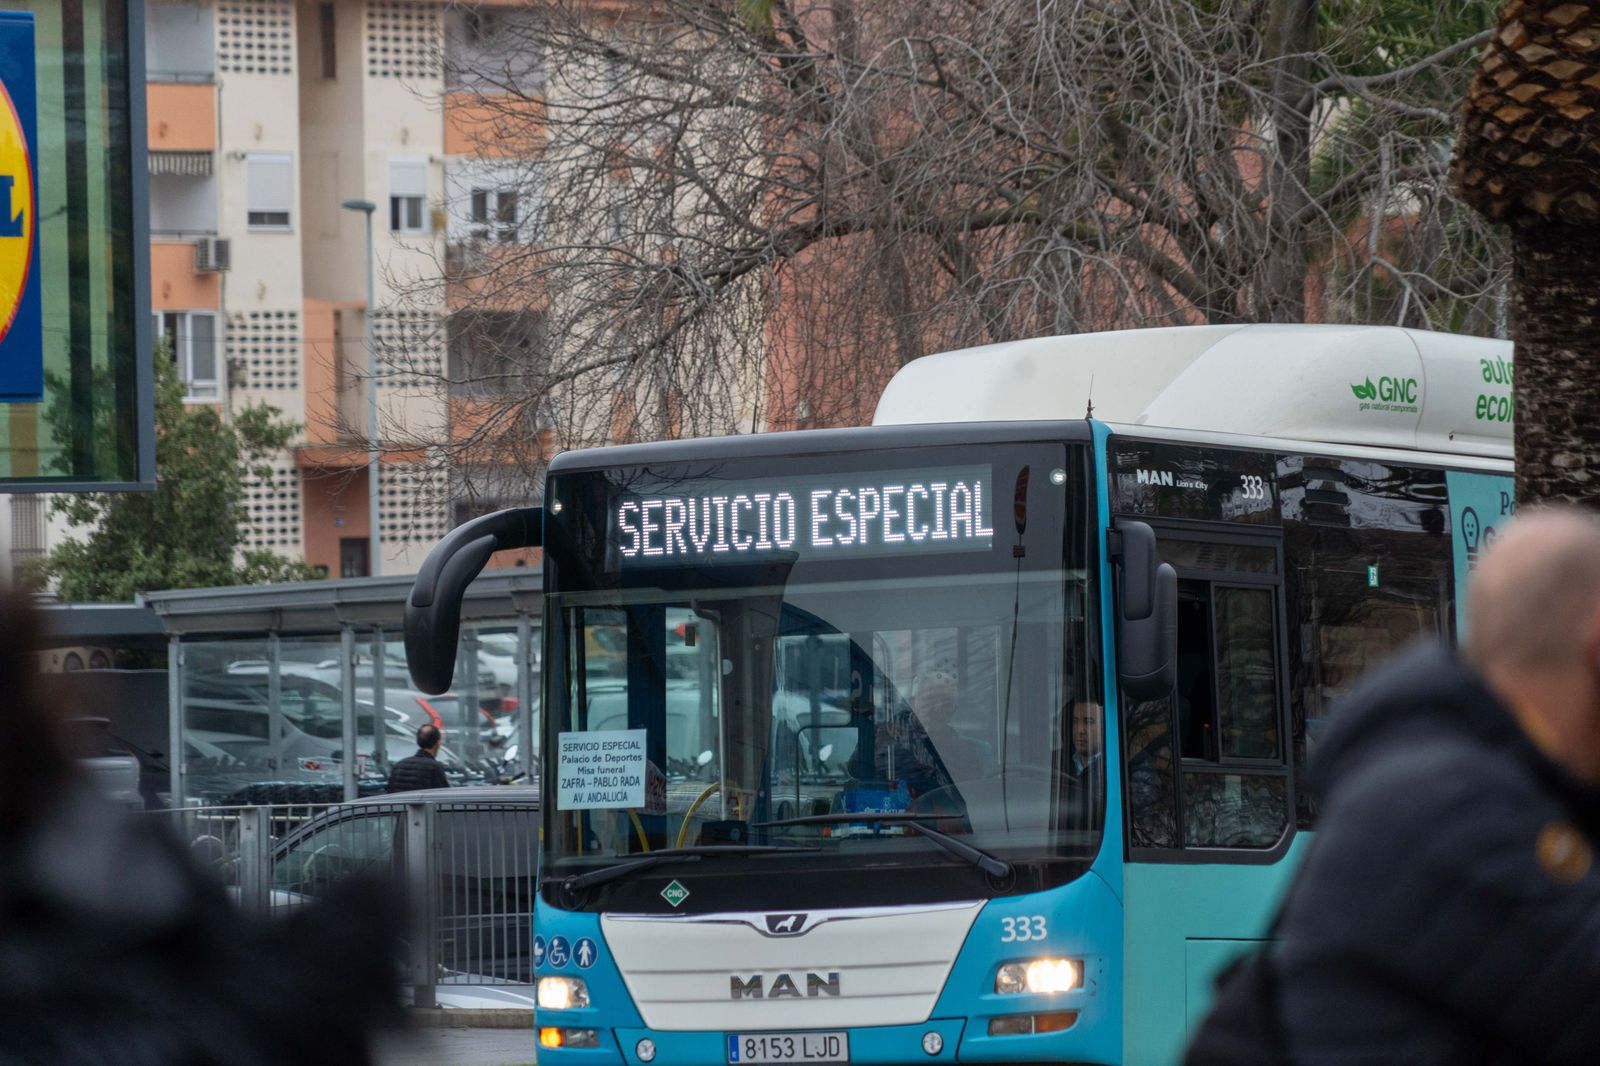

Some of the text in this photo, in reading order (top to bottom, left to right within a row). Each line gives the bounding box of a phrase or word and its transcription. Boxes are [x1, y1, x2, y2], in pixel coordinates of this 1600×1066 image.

[1378, 376, 1418, 404] GNC
[1136, 469, 1173, 486] MAN
[1194, 481, 1209, 491] City
[1240, 474, 1264, 500] 333
[618, 480, 994, 557] SERVICIO ESPECIAL
[562, 740, 641, 752] SERVICIO ESPECIAL
[561, 752, 642, 764] Palacio de Deportes
[577, 764, 626, 775] Misa funeral
[561, 777, 586, 789] ZAFRA
[593, 776, 618, 788] PABLO
[620, 774, 640, 787] RADA
[572, 788, 628, 804] AV. ANDALUCÍA
[667, 889, 683, 898] CNG
[1001, 914, 1048, 943] 333
[730, 972, 841, 999] MAN
[744, 1035, 840, 1060] 8153 LJD
